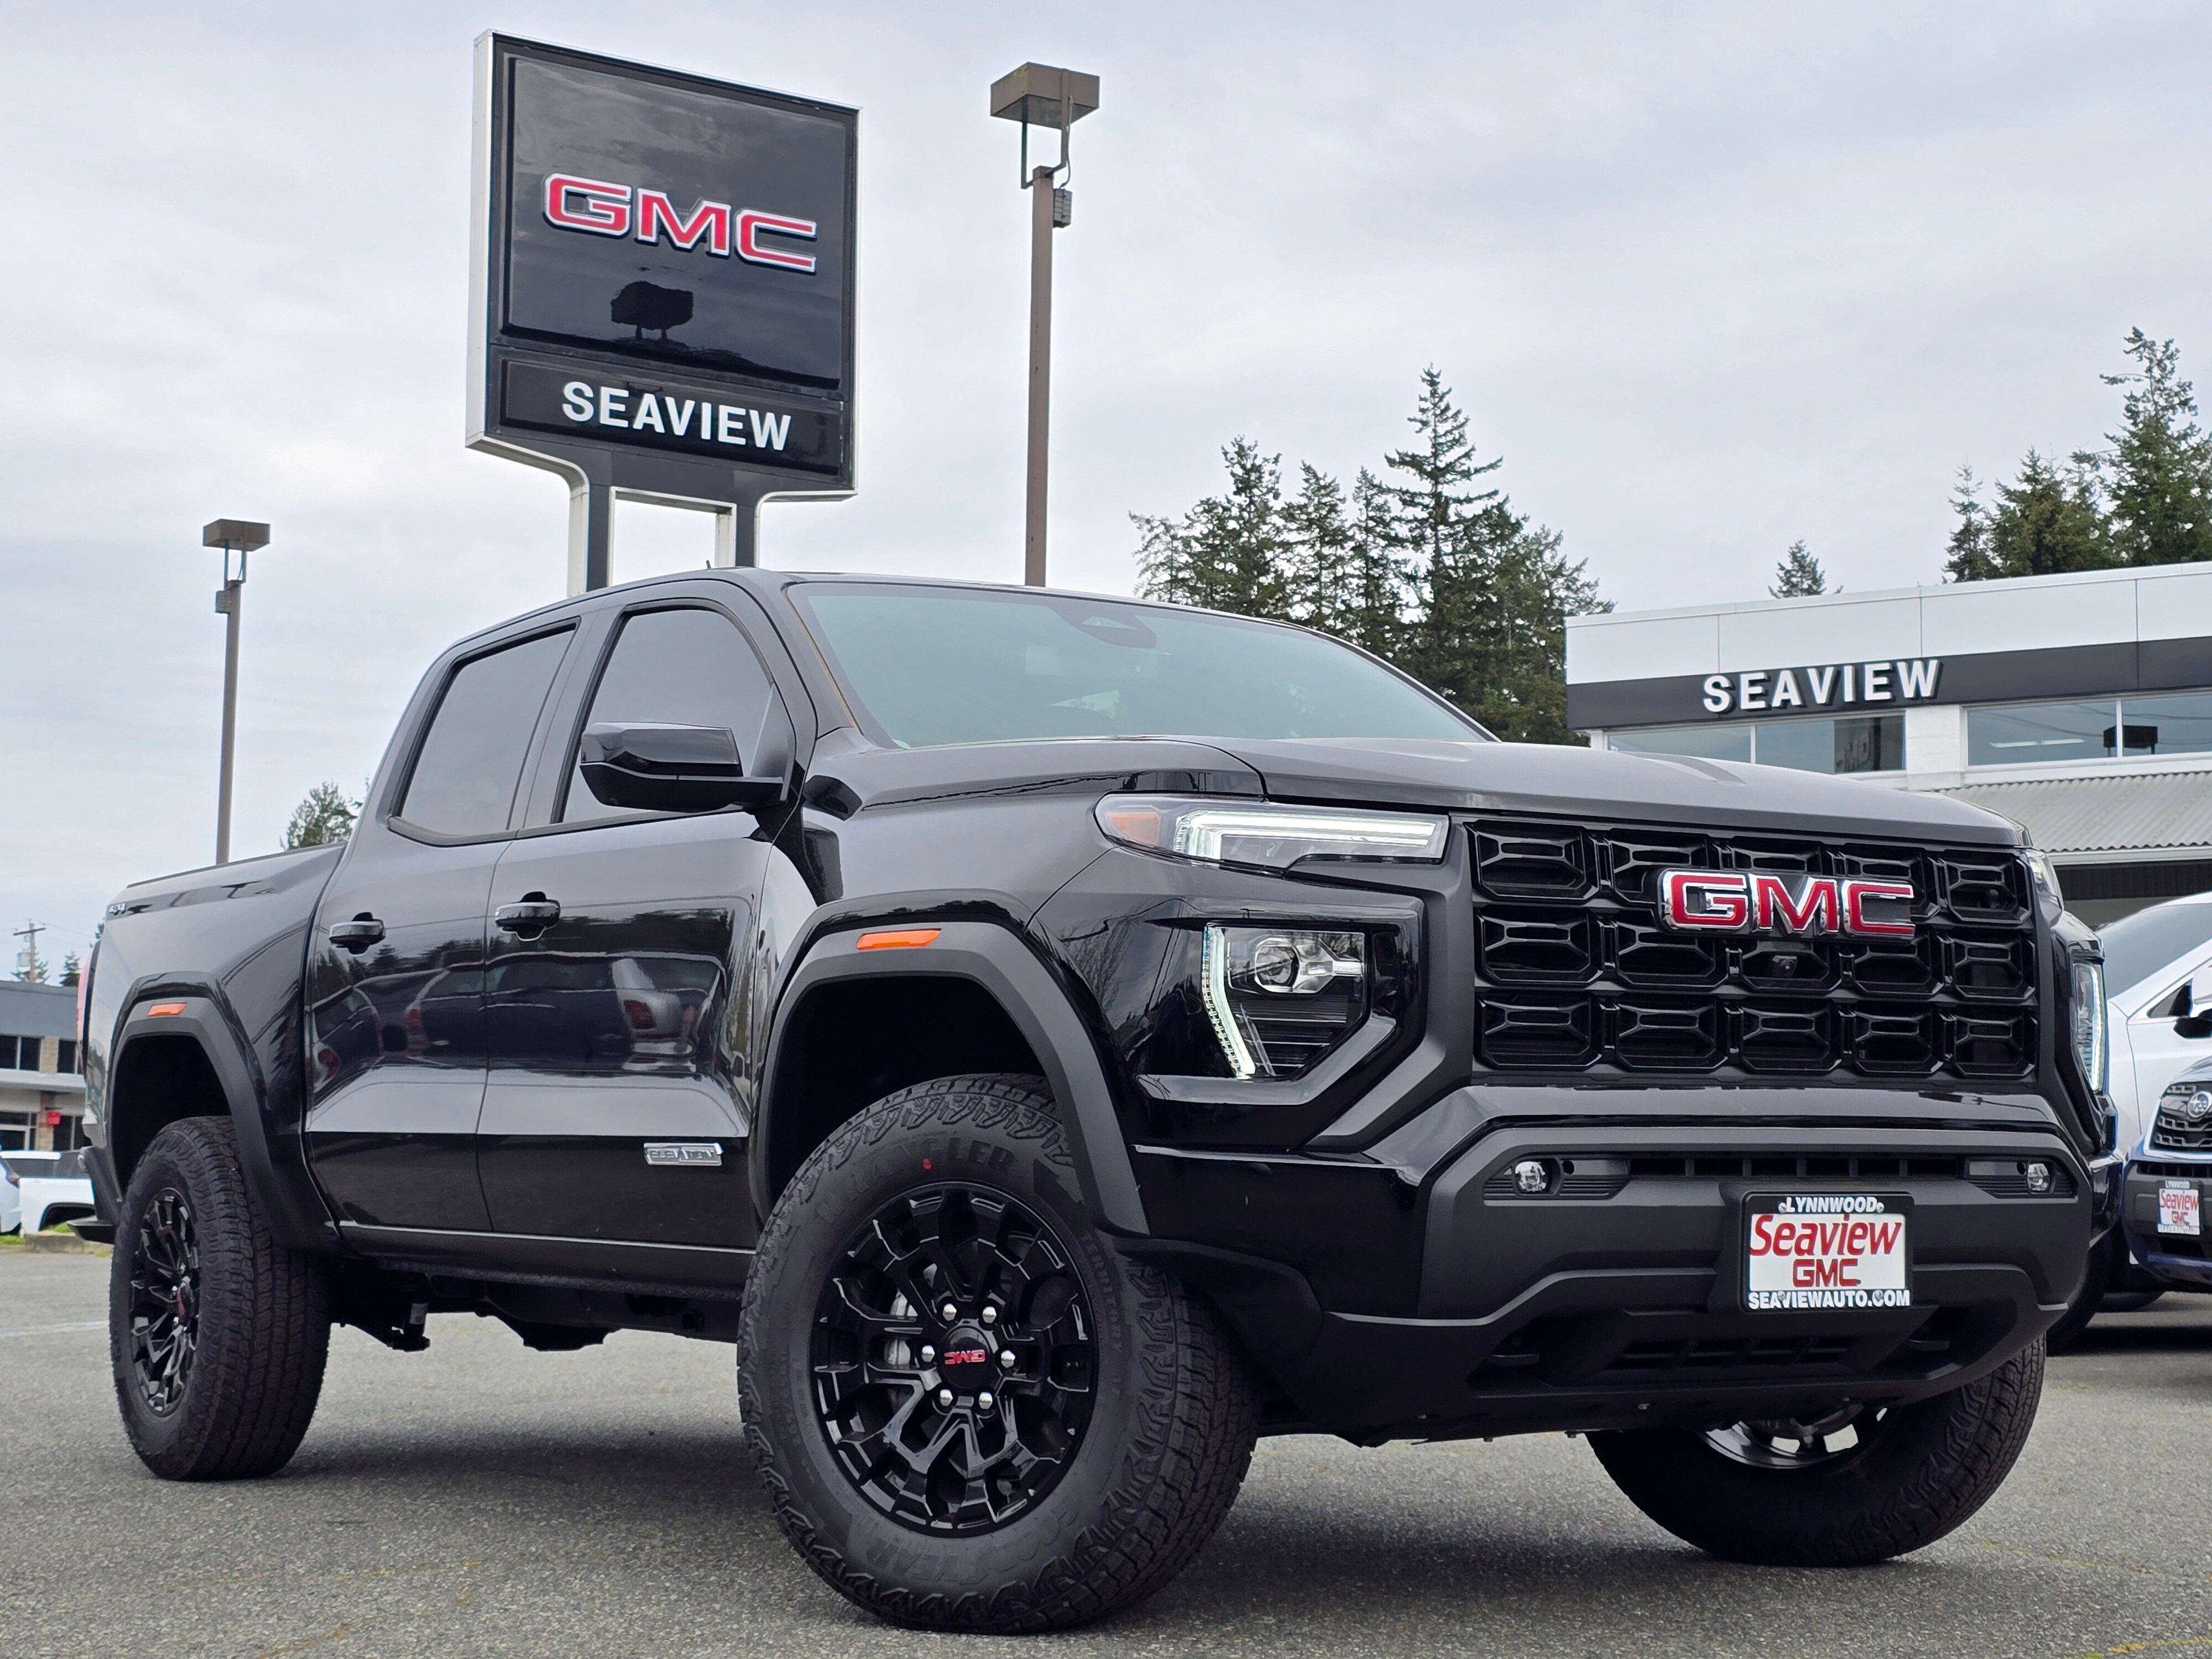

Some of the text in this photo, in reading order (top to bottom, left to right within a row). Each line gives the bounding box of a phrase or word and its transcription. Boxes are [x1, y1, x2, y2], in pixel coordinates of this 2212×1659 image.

[544, 173, 816, 274] GMC
[562, 381, 791, 451] SEAVIEW
[1703, 660, 1940, 713] SEAVIEW
[1661, 870, 1916, 940] GMC
[1786, 1197, 1878, 1213] LYNNWOOD
[2160, 1190, 2198, 1211] Seaview
[2172, 1211, 2190, 1226] GMC
[1750, 1214, 1902, 1256] Seaview
[1793, 1259, 1859, 1287] GMC
[1748, 1290, 1911, 1309] SEAVIEWAUTO.COM
[944, 1349, 985, 1365] GMC
